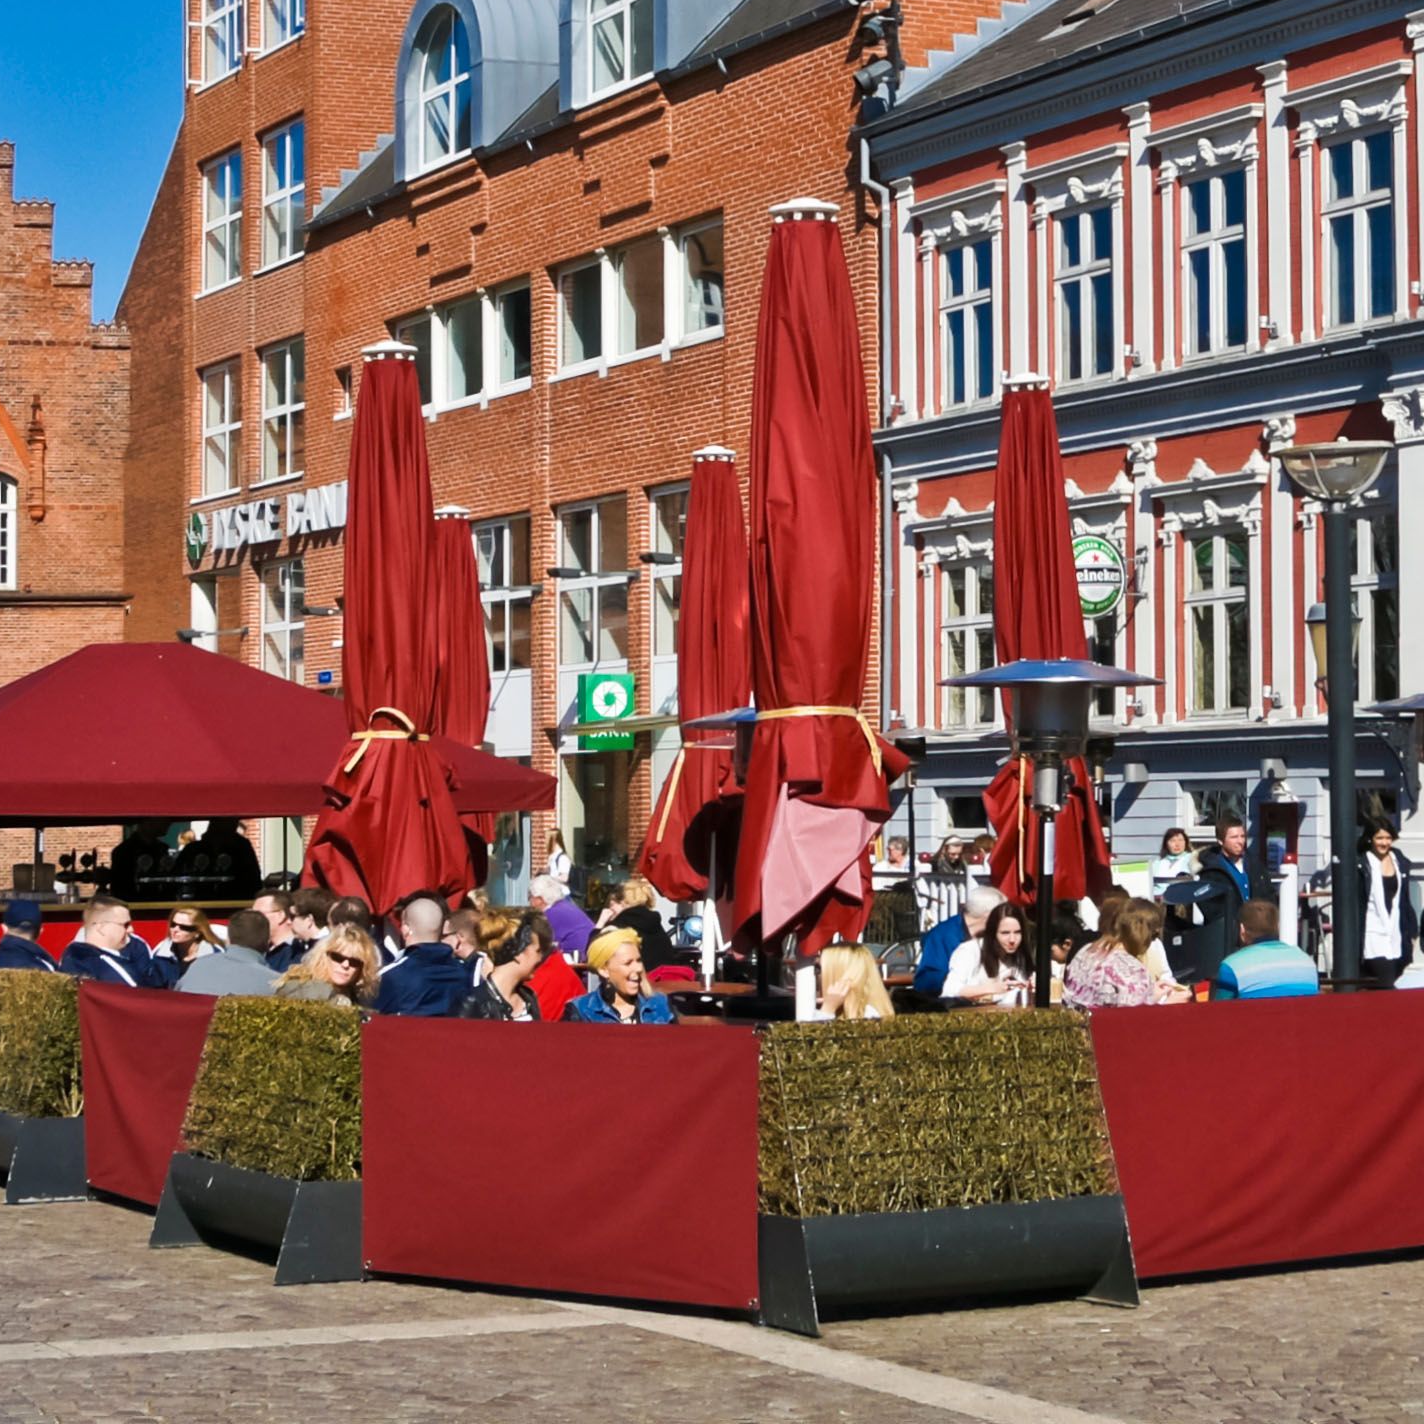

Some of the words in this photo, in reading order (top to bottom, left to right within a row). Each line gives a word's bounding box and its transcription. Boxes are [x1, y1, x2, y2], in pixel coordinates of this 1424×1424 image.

[211, 497, 282, 553] JYSKE
[287, 480, 349, 537] BAN
[1076, 568, 1121, 582] eineken
